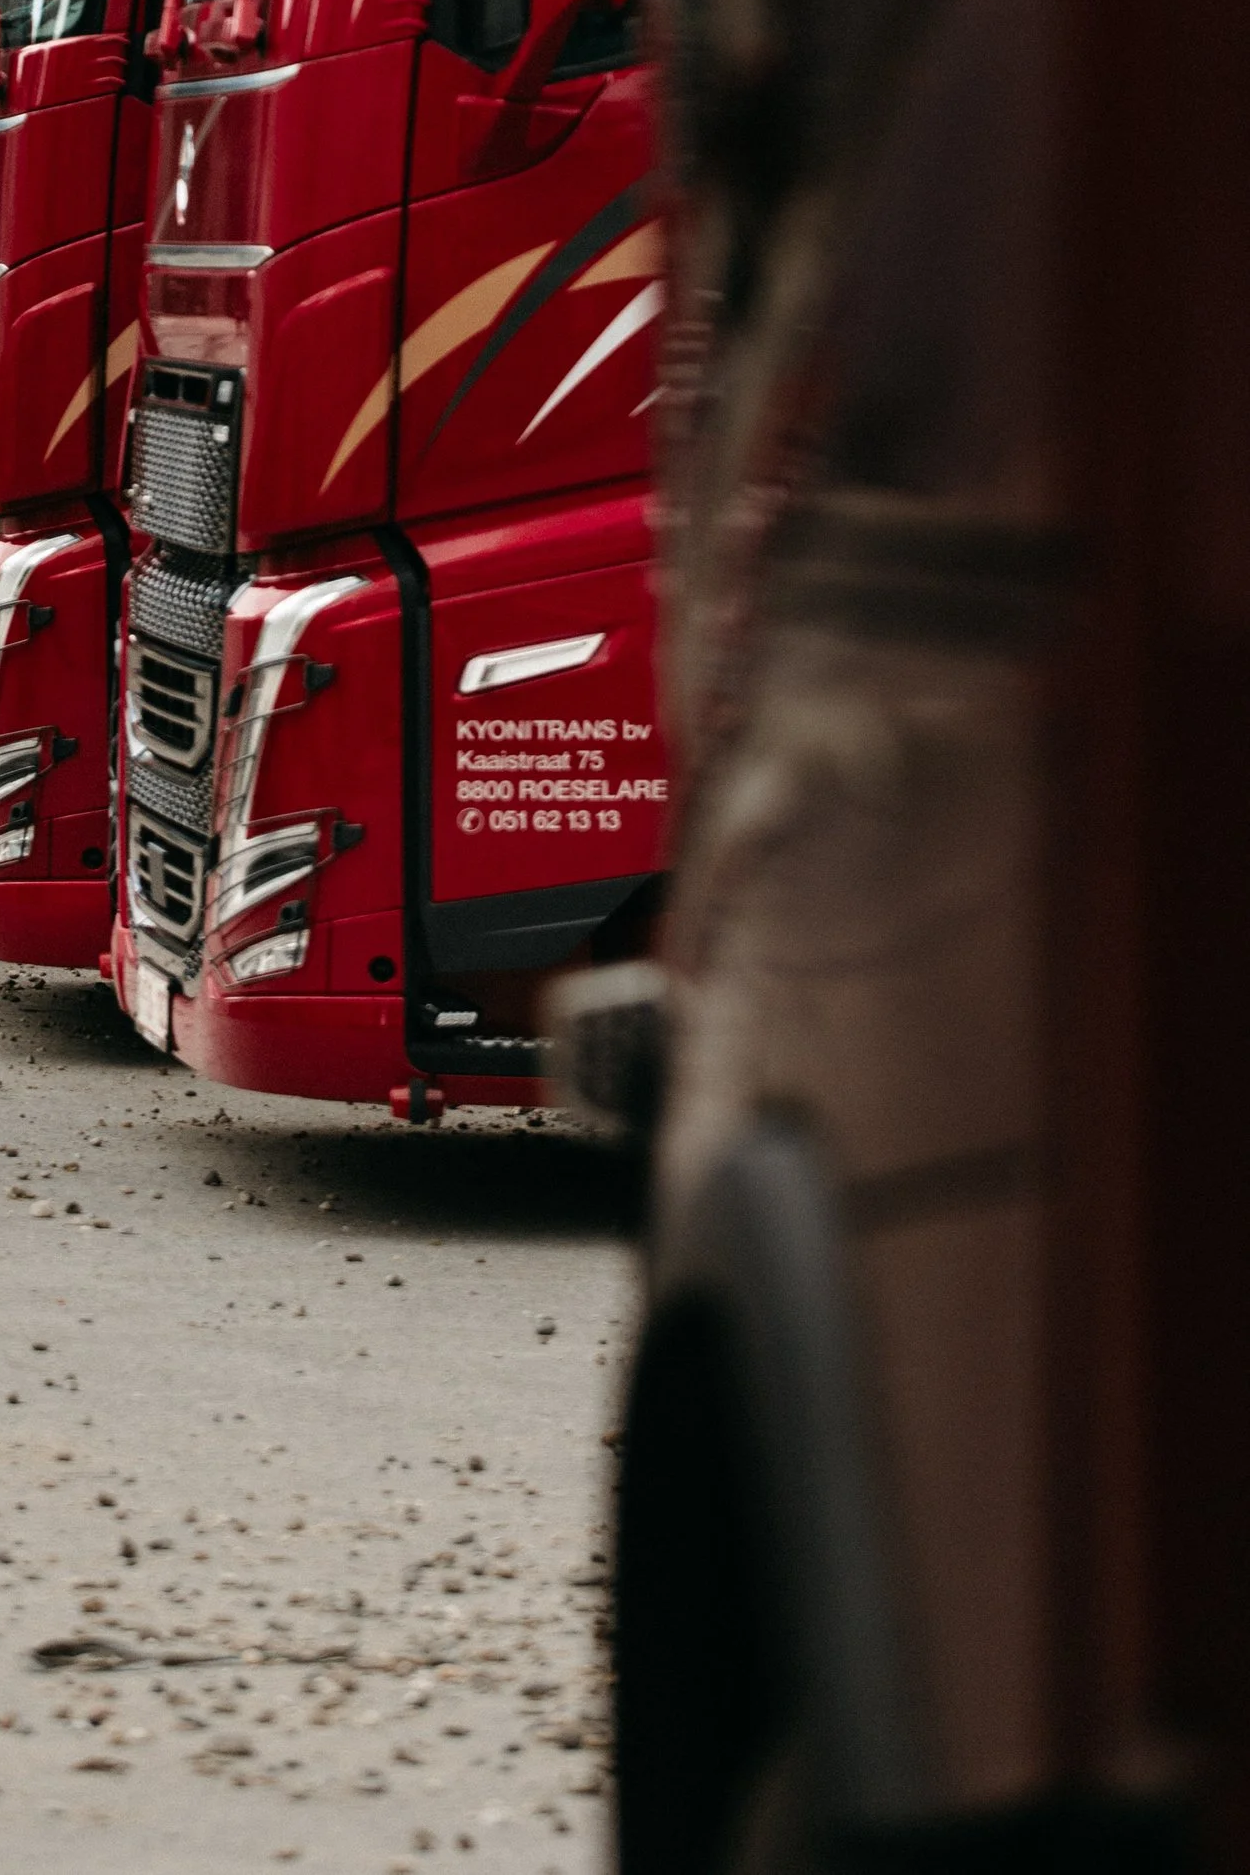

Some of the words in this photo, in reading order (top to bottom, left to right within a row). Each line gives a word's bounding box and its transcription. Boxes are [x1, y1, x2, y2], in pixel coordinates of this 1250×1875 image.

[456, 719, 618, 740] KYONITRANS
[622, 719, 652, 740] bv
[456, 749, 572, 771] Kaaistraat
[576, 749, 605, 771] 75
[456, 779, 515, 801] 8800
[518, 779, 669, 801] ROESELARE
[488, 809, 528, 831] 051
[532, 809, 563, 831] 62
[565, 809, 592, 831] 13
[595, 809, 622, 831] 13
